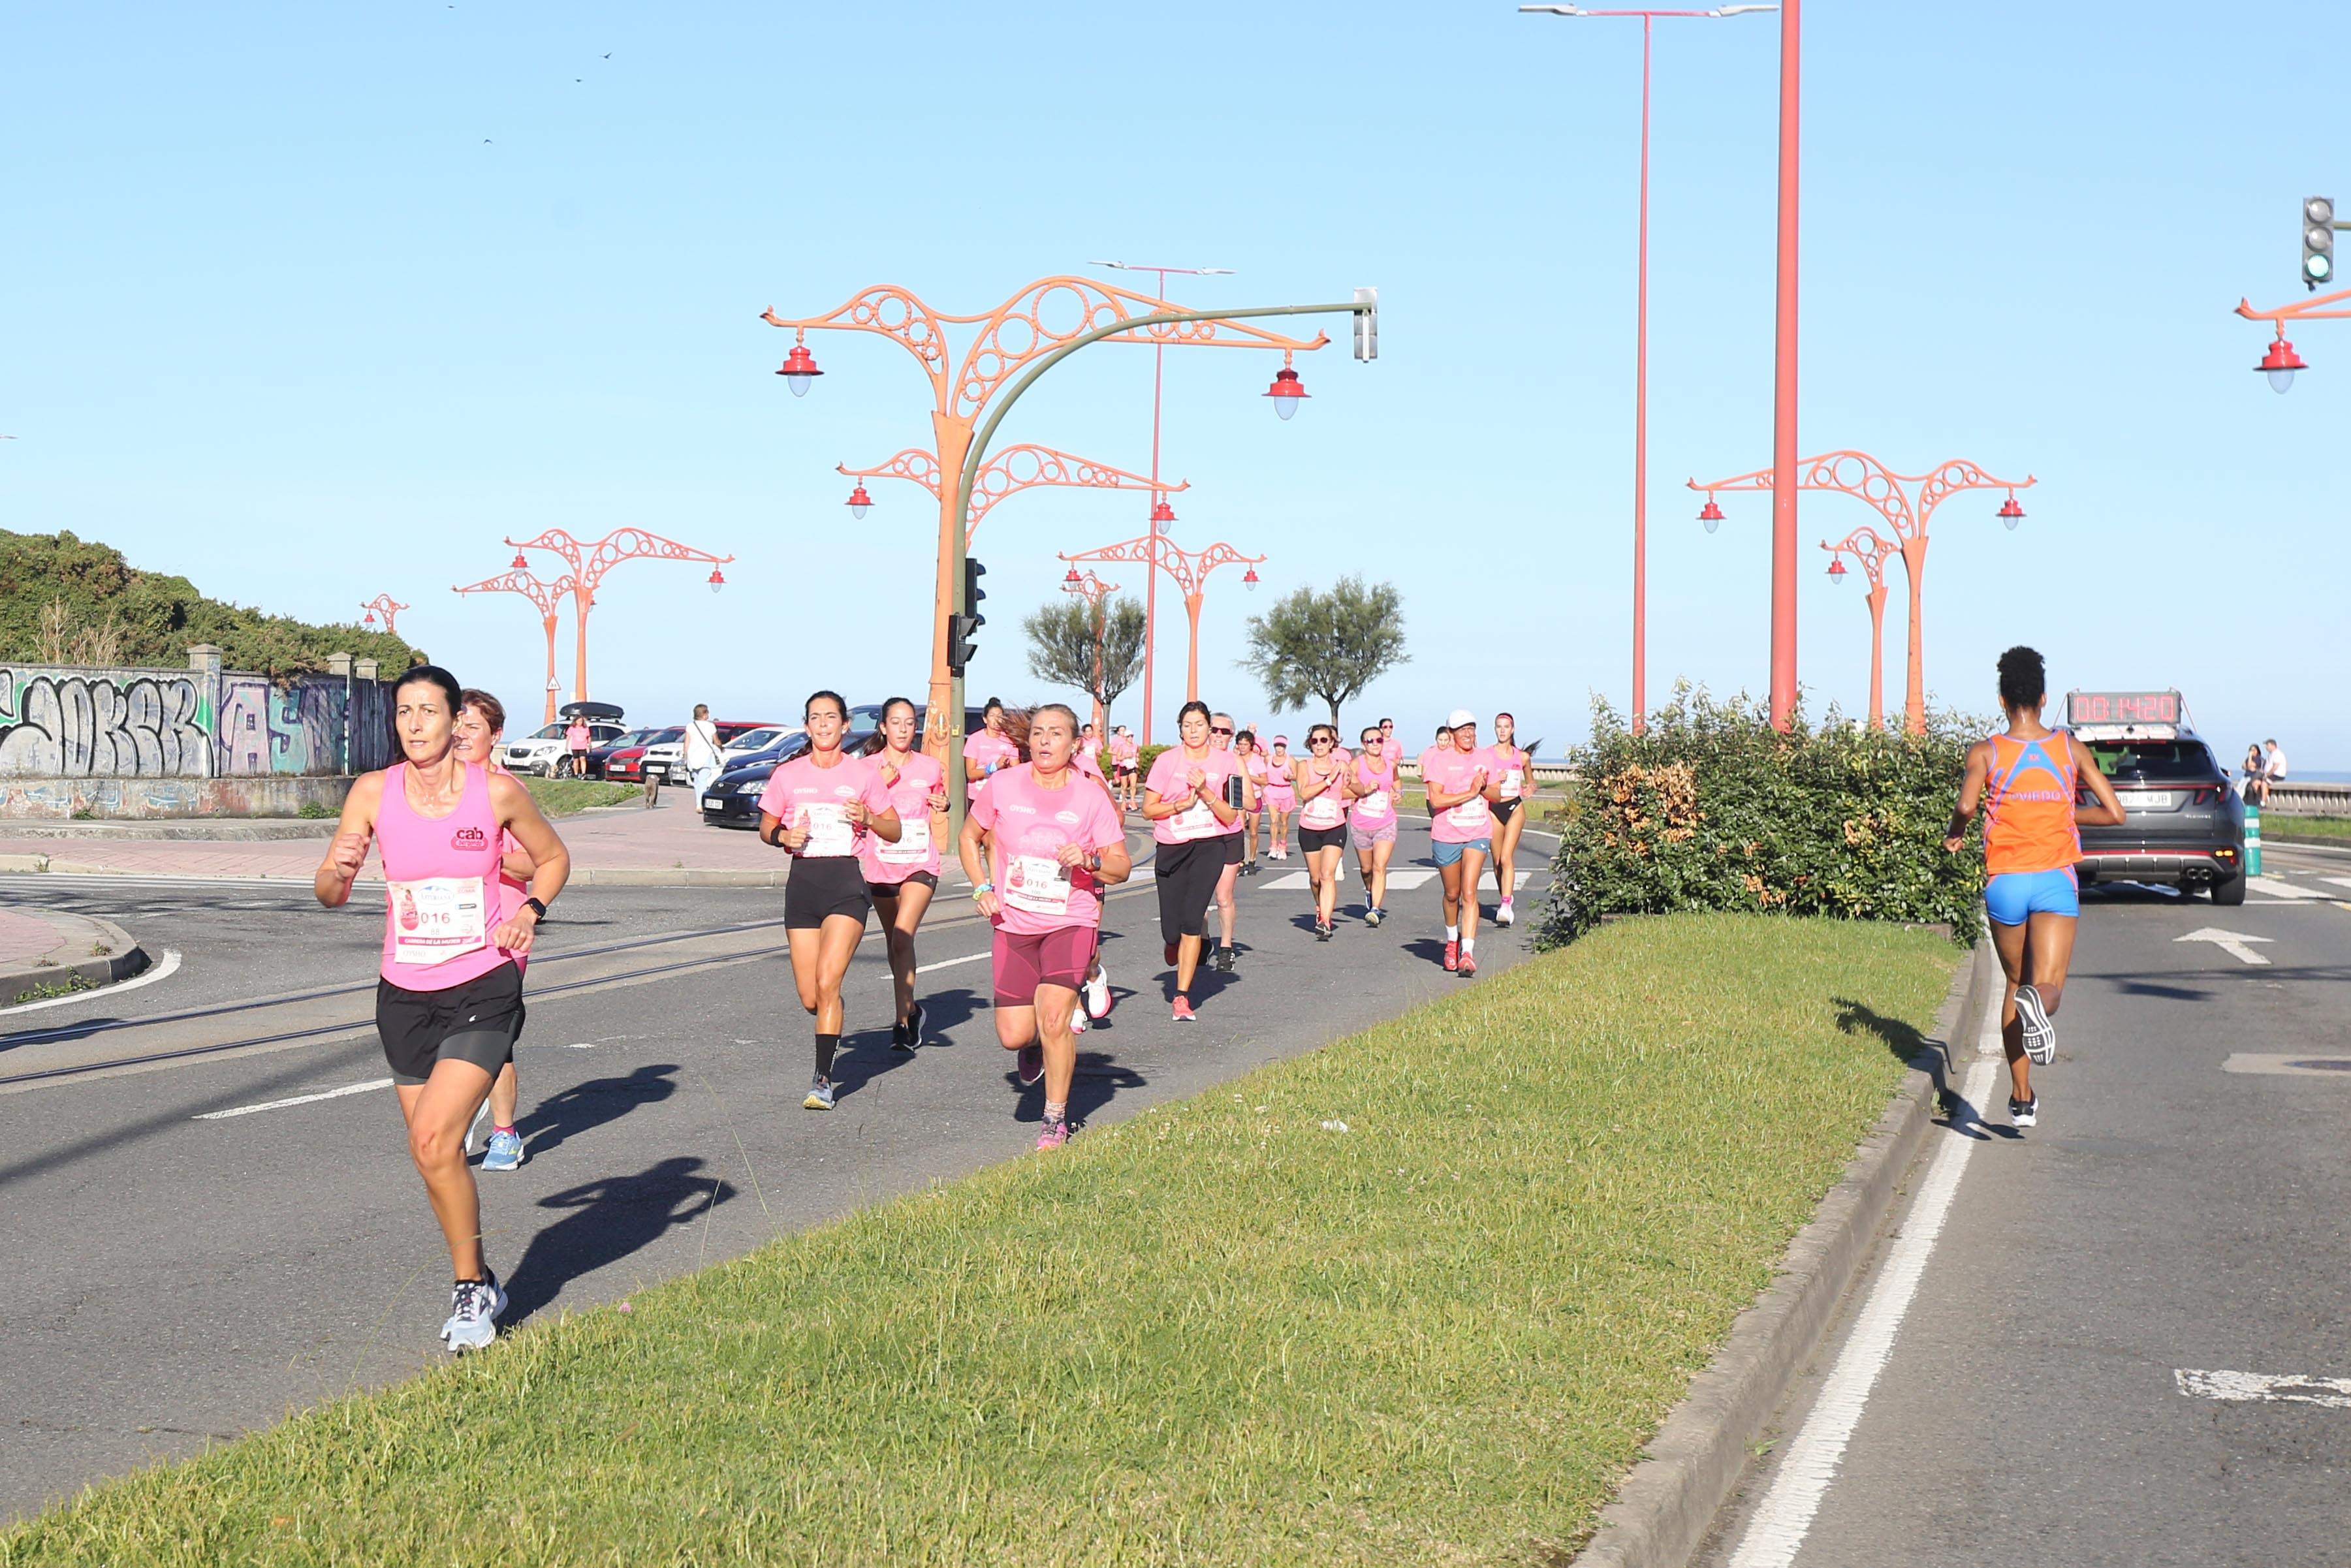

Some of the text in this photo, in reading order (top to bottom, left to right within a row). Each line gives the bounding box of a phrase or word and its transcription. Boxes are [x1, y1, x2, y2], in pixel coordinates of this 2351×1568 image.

[2009, 791, 2061, 801] OVIEDO
[1009, 804, 1036, 815] OYSHO
[456, 826, 484, 840] cab
[1026, 879, 1047, 889] 016
[420, 913, 450, 924] 016
